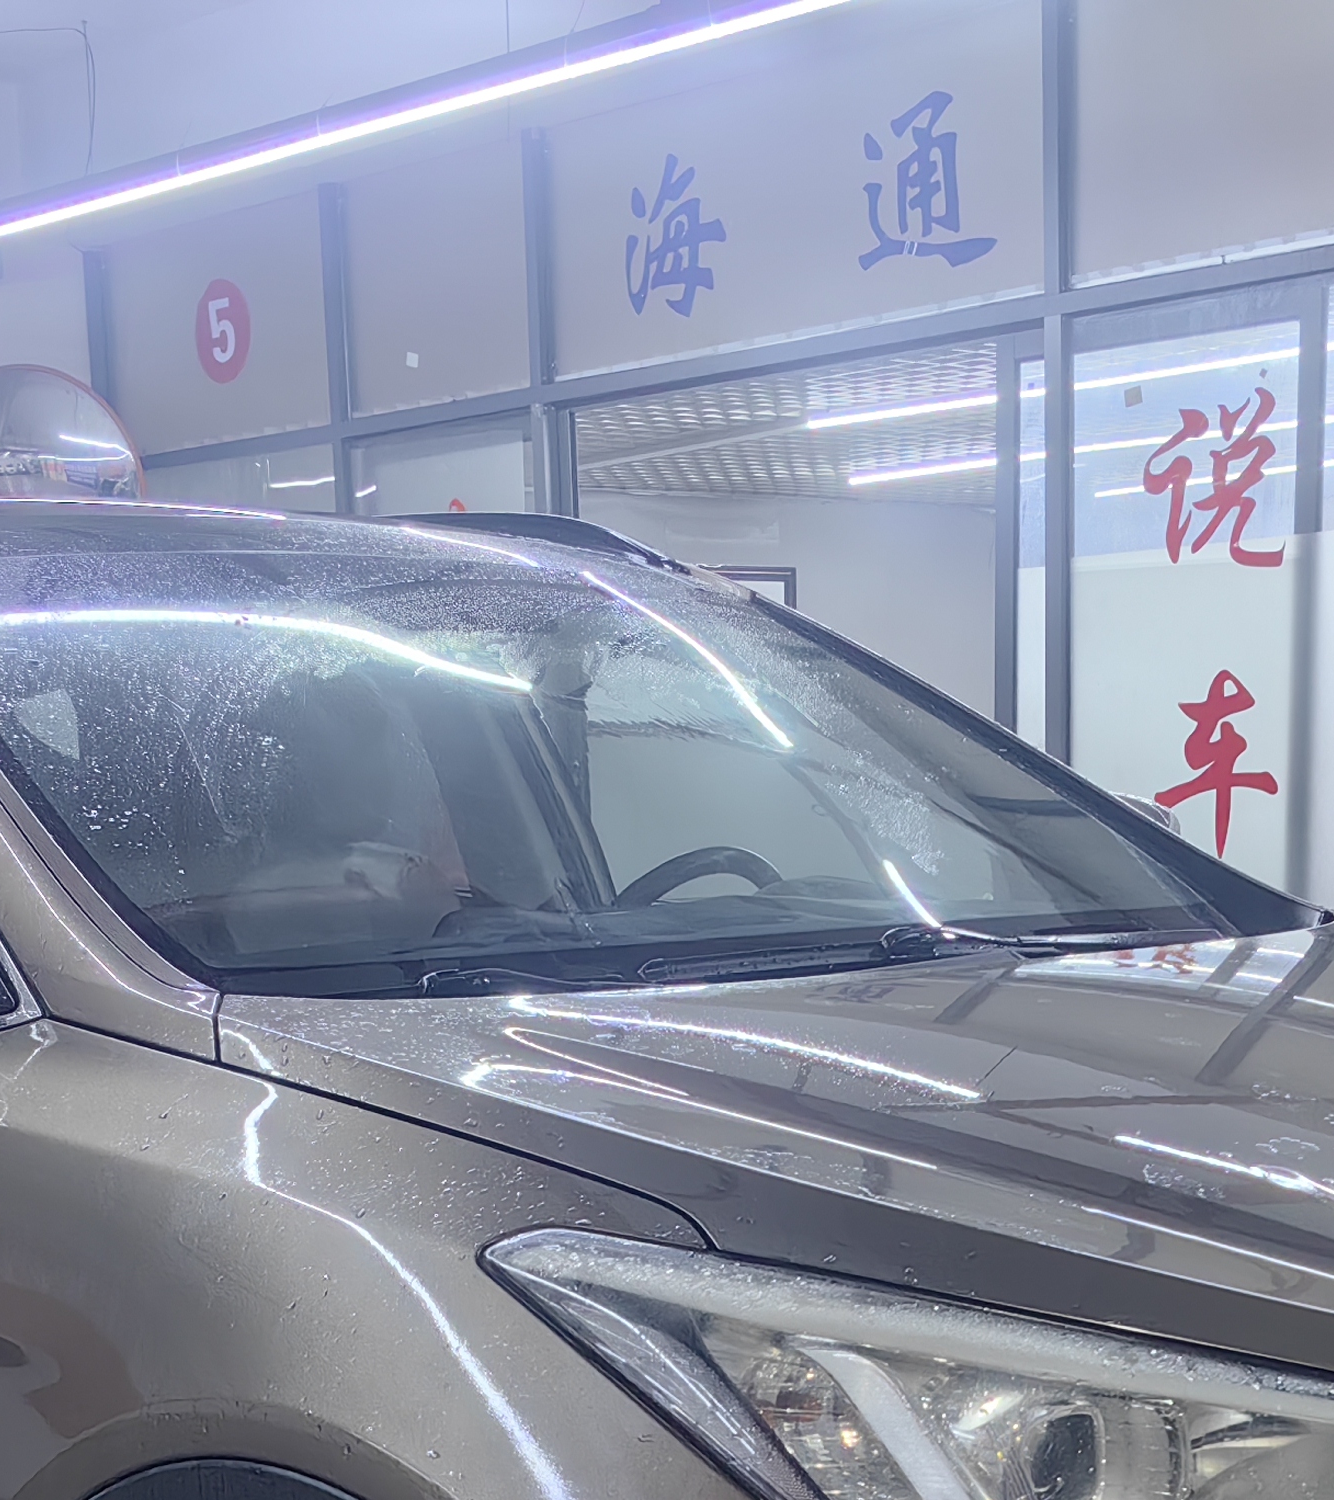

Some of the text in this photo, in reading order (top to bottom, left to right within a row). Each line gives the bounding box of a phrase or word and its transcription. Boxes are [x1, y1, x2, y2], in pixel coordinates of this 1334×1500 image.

[624, 89, 998, 319] 海通
[207, 297, 237, 363] 5
[1143, 386, 1287, 859] 说车
